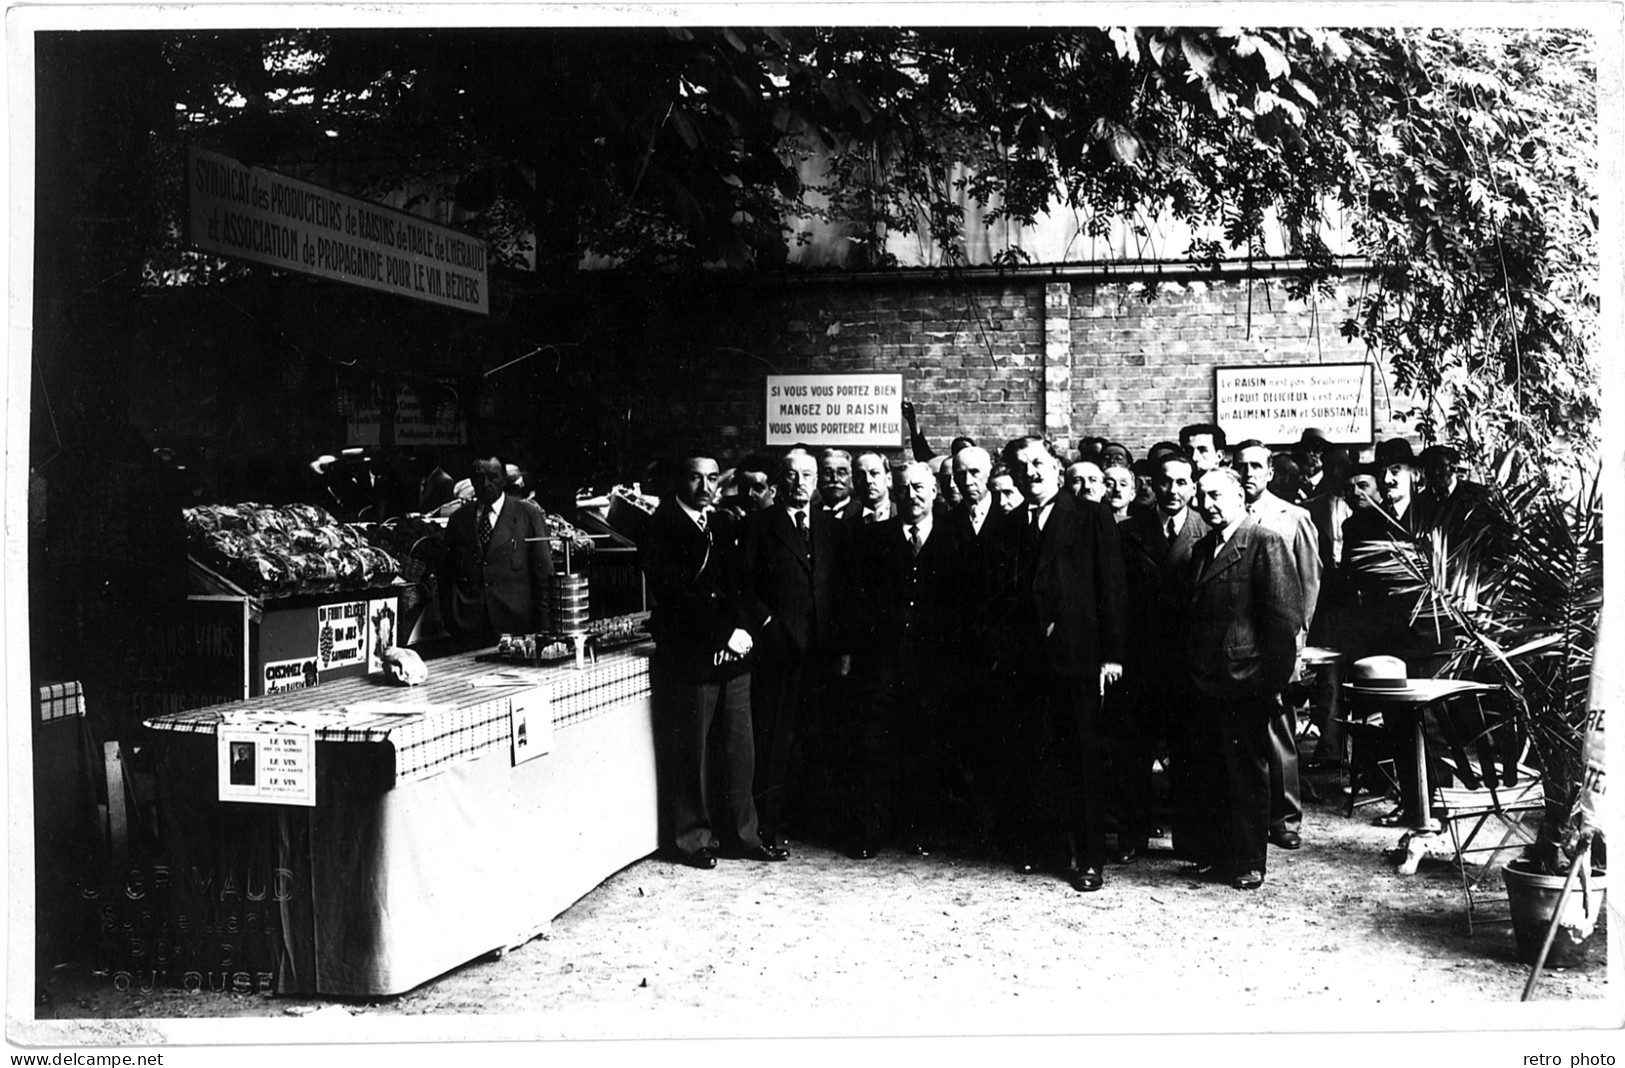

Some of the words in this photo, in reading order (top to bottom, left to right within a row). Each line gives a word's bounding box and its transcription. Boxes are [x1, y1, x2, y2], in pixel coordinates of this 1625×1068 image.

[196, 157, 250, 205] SYNDICAT
[252, 176, 270, 210] des
[271, 181, 342, 232] PRODUCTEURS
[344, 205, 357, 236] de
[358, 209, 395, 247] RAISINS
[396, 222, 407, 251] de
[407, 225, 433, 258] TABLE
[434, 233, 445, 261] de
[207, 208, 220, 242] et
[223, 211, 298, 262] ASSOCIATION
[302, 233, 316, 266] de
[317, 236, 383, 283] PROPAGANDE
[386, 255, 411, 289] POUR
[413, 263, 425, 292] LE
[1221, 378, 1232, 388] Le
[1234, 377, 1266, 387] RAISIN
[1290, 379, 1305, 388] pas
[771, 385, 781, 397] SI
[784, 385, 808, 397] VOUS
[810, 385, 834, 397] VOUS
[836, 385, 870, 397] PORTEZ
[874, 385, 897, 396] BIEN
[1221, 395, 1232, 403] un
[1234, 392, 1259, 403] FRUIT
[780, 403, 821, 416] MANGEZ
[826, 404, 841, 416] DU
[846, 403, 888, 415] RAISIN
[1232, 408, 1271, 420] ALIMENT
[1273, 408, 1297, 419] SAIN
[1299, 408, 1308, 418] et
[769, 422, 792, 434] VOUS
[795, 422, 818, 434] VOUS
[821, 422, 865, 434] PORTEREZ
[869, 422, 900, 434] MIEUX
[345, 625, 357, 641] JUS
[283, 738, 297, 746] VIN
[283, 758, 297, 766] VIN
[283, 778, 297, 786] VIN
